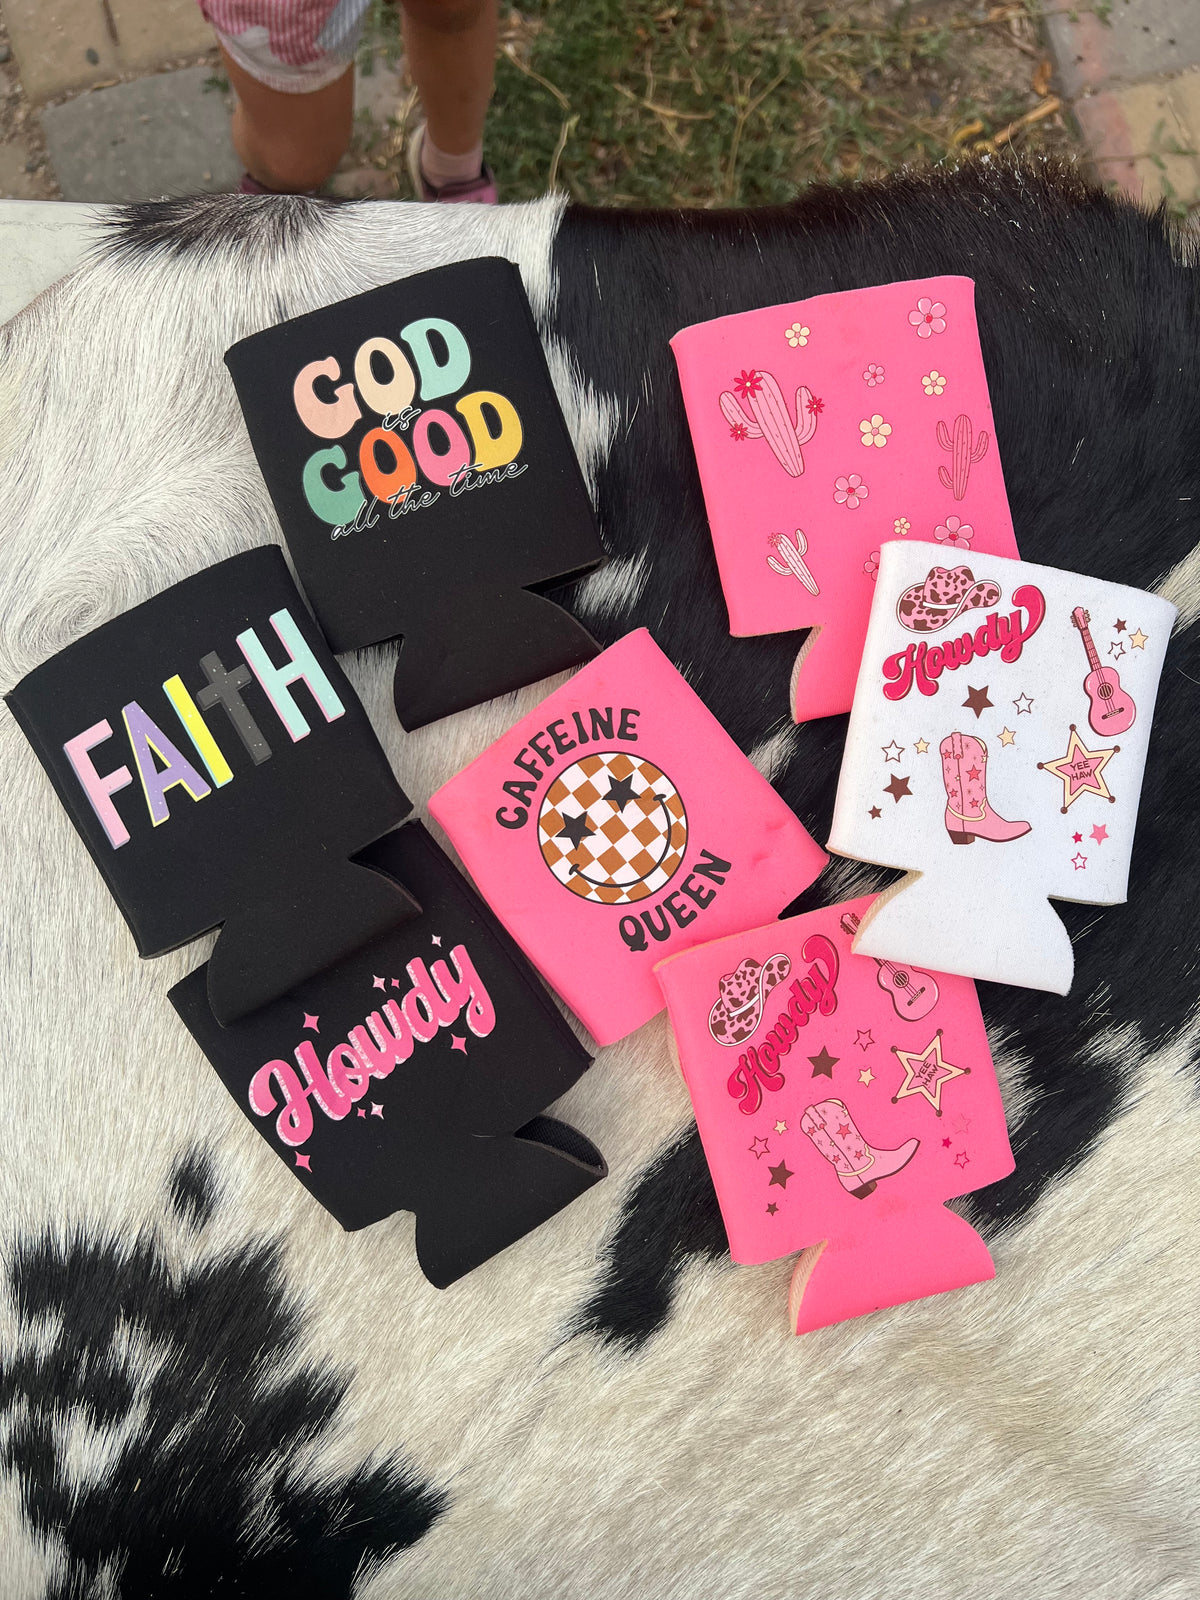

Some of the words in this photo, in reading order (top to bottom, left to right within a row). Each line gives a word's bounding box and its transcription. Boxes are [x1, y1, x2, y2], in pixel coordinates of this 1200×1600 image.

[293, 317, 472, 440] GOD
[381, 405, 421, 432] is
[302, 390, 523, 526] GOOD
[330, 496, 380, 541] all
[386, 483, 441, 520] the
[448, 462, 529, 498] time
[882, 584, 1046, 701] Howdy
[495, 706, 641, 830] CAFFEINE
[1070, 760, 1090, 771] YEE
[1071, 769, 1093, 781] HAW
[618, 848, 732, 952] QUEEN
[248, 944, 497, 1148] Howdy
[727, 934, 840, 1116] Howdy
[915, 1061, 931, 1079] YEE
[922, 1064, 938, 1087] HAW
